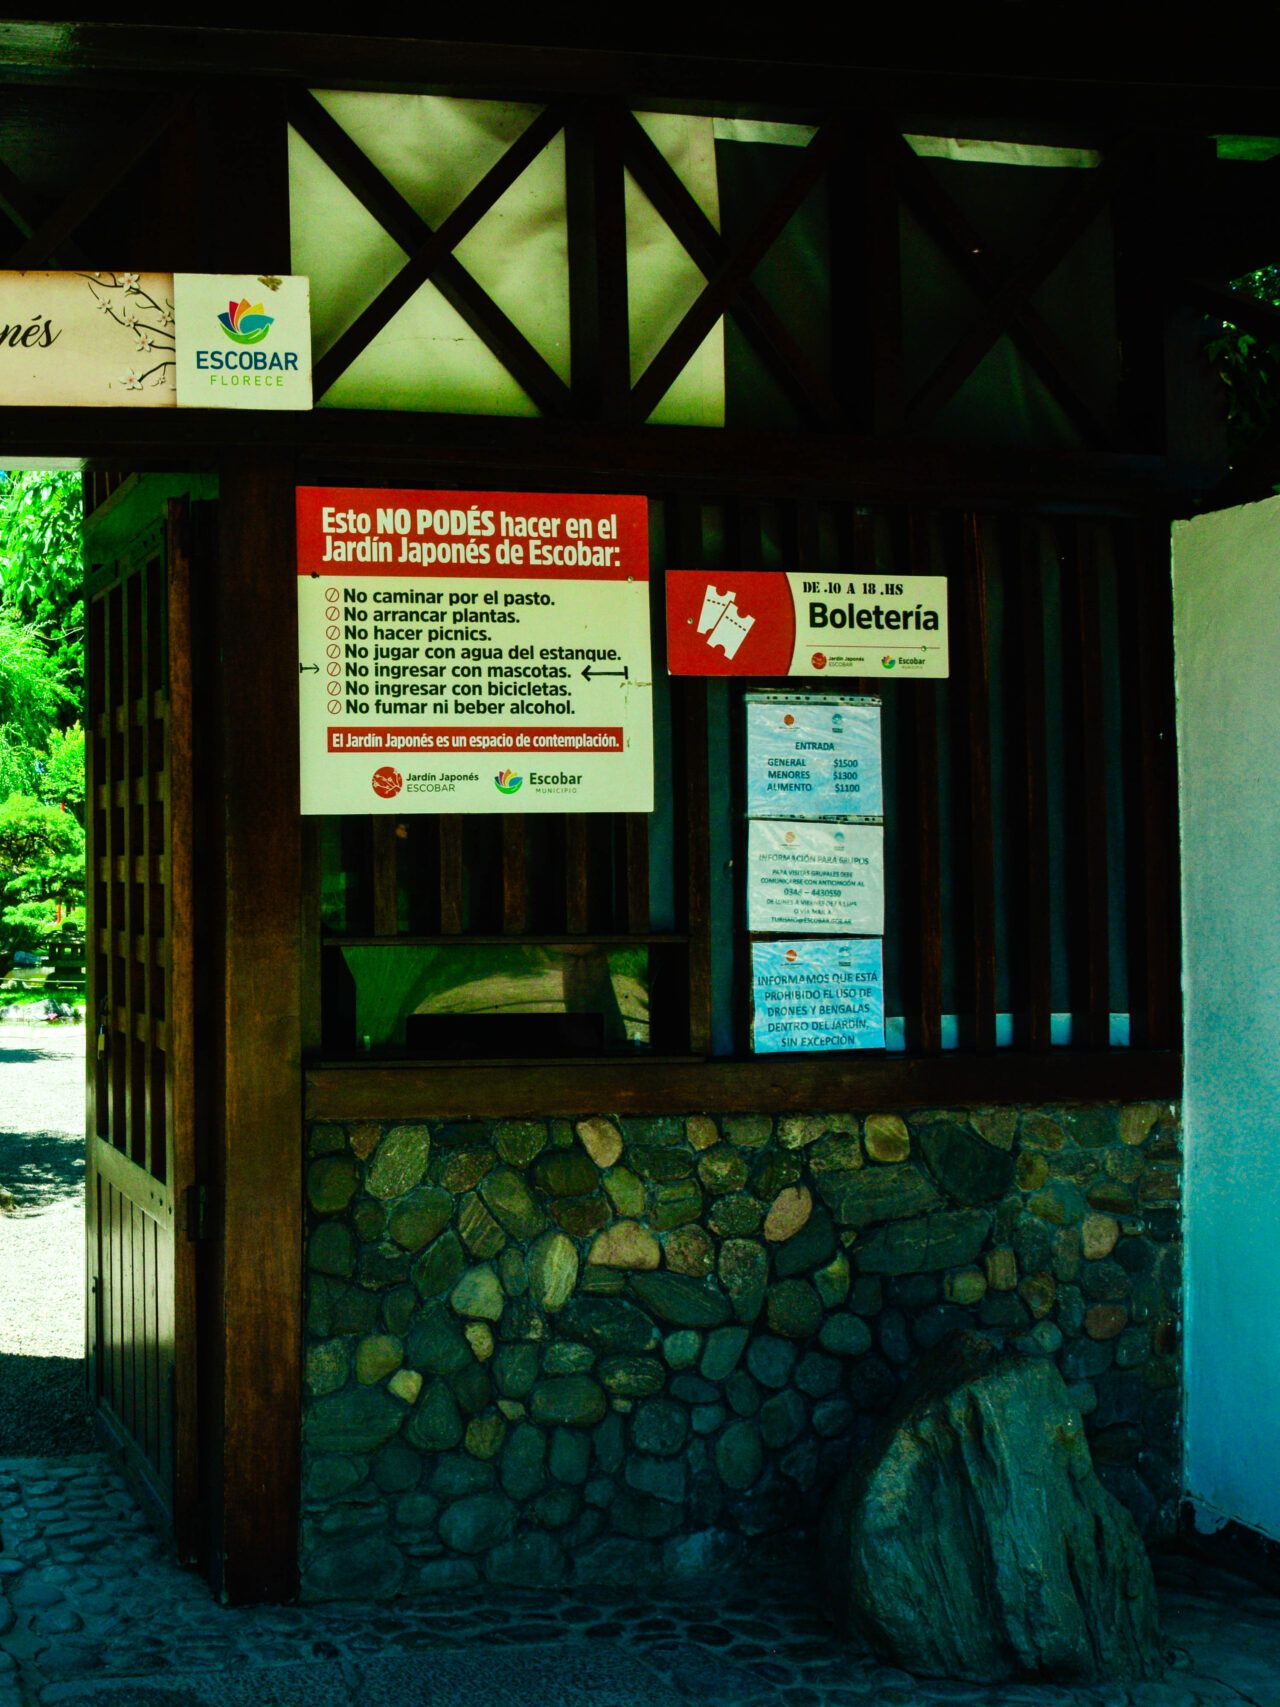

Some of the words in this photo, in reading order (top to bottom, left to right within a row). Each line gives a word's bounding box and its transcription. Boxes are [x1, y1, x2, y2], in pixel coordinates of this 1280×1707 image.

[196, 352, 298, 371] ESCOBAR
[210, 375, 284, 387] FLORECE
[322, 507, 371, 534] Esto
[376, 509, 412, 534] NO
[417, 506, 494, 536] PODÉS
[500, 512, 560, 538] hacer
[566, 520, 594, 539] en
[597, 514, 617, 539] el
[322, 537, 393, 562] Jardín
[398, 538, 488, 567] Japonés
[496, 540, 524, 564] de
[529, 540, 621, 567] Escobar:
[803, 582, 820, 594] DE
[846, 583, 856, 594] A
[862, 583, 876, 594] 18
[343, 589, 368, 603] No
[372, 590, 444, 604] caminar
[449, 592, 478, 606] por
[483, 590, 499, 604] el
[504, 592, 555, 606] pasto.
[344, 608, 368, 621] No
[373, 609, 447, 622] arrancar
[452, 609, 520, 624] plantas.
[809, 602, 939, 630] Boletería
[344, 626, 369, 640] No
[374, 626, 423, 640] hacer
[428, 626, 491, 643] picnics.
[345, 645, 369, 659] No
[373, 645, 420, 662] jugar
[424, 647, 456, 659] con
[460, 647, 503, 662] agua
[508, 646, 534, 660] del
[539, 647, 621, 662] estanque.
[898, 657, 925, 665] Escobar
[345, 663, 369, 677] No
[374, 664, 447, 680] ingresar
[452, 665, 483, 677] con
[487, 665, 571, 679] mascotas.
[345, 682, 370, 696] No
[374, 682, 448, 698] ingresar
[452, 684, 483, 696] con
[488, 682, 572, 697] bicicletas.
[345, 701, 370, 714] No
[374, 700, 428, 714] fumar
[432, 701, 449, 714] ni
[454, 701, 505, 714] beber
[510, 701, 575, 715] alcohol.
[332, 734, 343, 748] El
[346, 734, 382, 748] Jardín
[385, 733, 434, 750] Japonés
[436, 736, 449, 748] es
[452, 736, 466, 748] un
[469, 735, 513, 751] espacio
[516, 735, 531, 748] de
[533, 734, 619, 749] contemplación.
[796, 742, 835, 750] ENTRADA
[834, 759, 858, 768] $1500
[406, 773, 436, 782] Jardín
[439, 773, 479, 783] Japonés
[530, 773, 582, 785] Escobar
[768, 771, 810, 779] MENORES
[834, 771, 858, 780] $1300
[407, 785, 456, 793] ESCOBAR
[767, 783, 812, 791] ALIMENTO
[835, 783, 859, 792] $1100
[758, 974, 829, 986] INFORMAMOS
[832, 973, 853, 983] QUE
[856, 970, 878, 982] ESTÁ
[765, 989, 820, 1001] PROHIBIDO
[824, 990, 834, 999] EL
[836, 989, 856, 997] USO
[859, 988, 872, 997] DE
[768, 1006, 807, 1016] DRONES
[811, 1006, 817, 1015] Y
[820, 1004, 870, 1015] BENGALAS
[768, 1021, 808, 1032] DENTRO
[812, 1021, 829, 1030] DEL
[781, 1037, 797, 1047] SIN
[801, 1035, 855, 1046] EXCEPCIÓN
